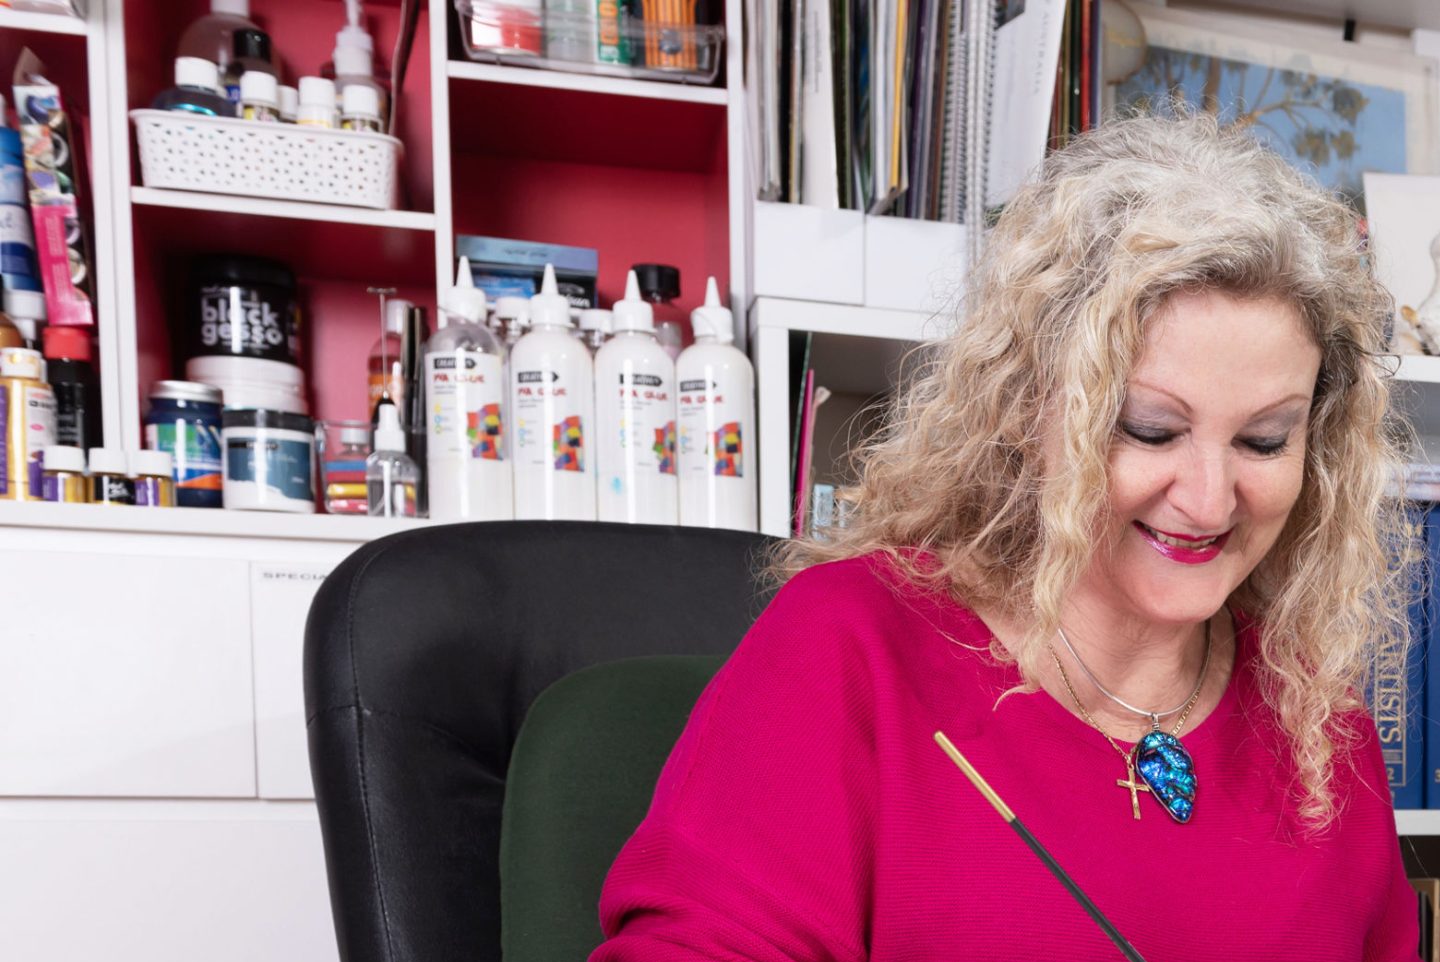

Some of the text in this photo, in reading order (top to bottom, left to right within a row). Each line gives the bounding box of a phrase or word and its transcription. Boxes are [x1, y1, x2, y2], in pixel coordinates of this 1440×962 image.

[1033, 12, 1050, 95] AUSTRALIA
[201, 322, 283, 347] gesso
[263, 572, 326, 580] SPECIA
